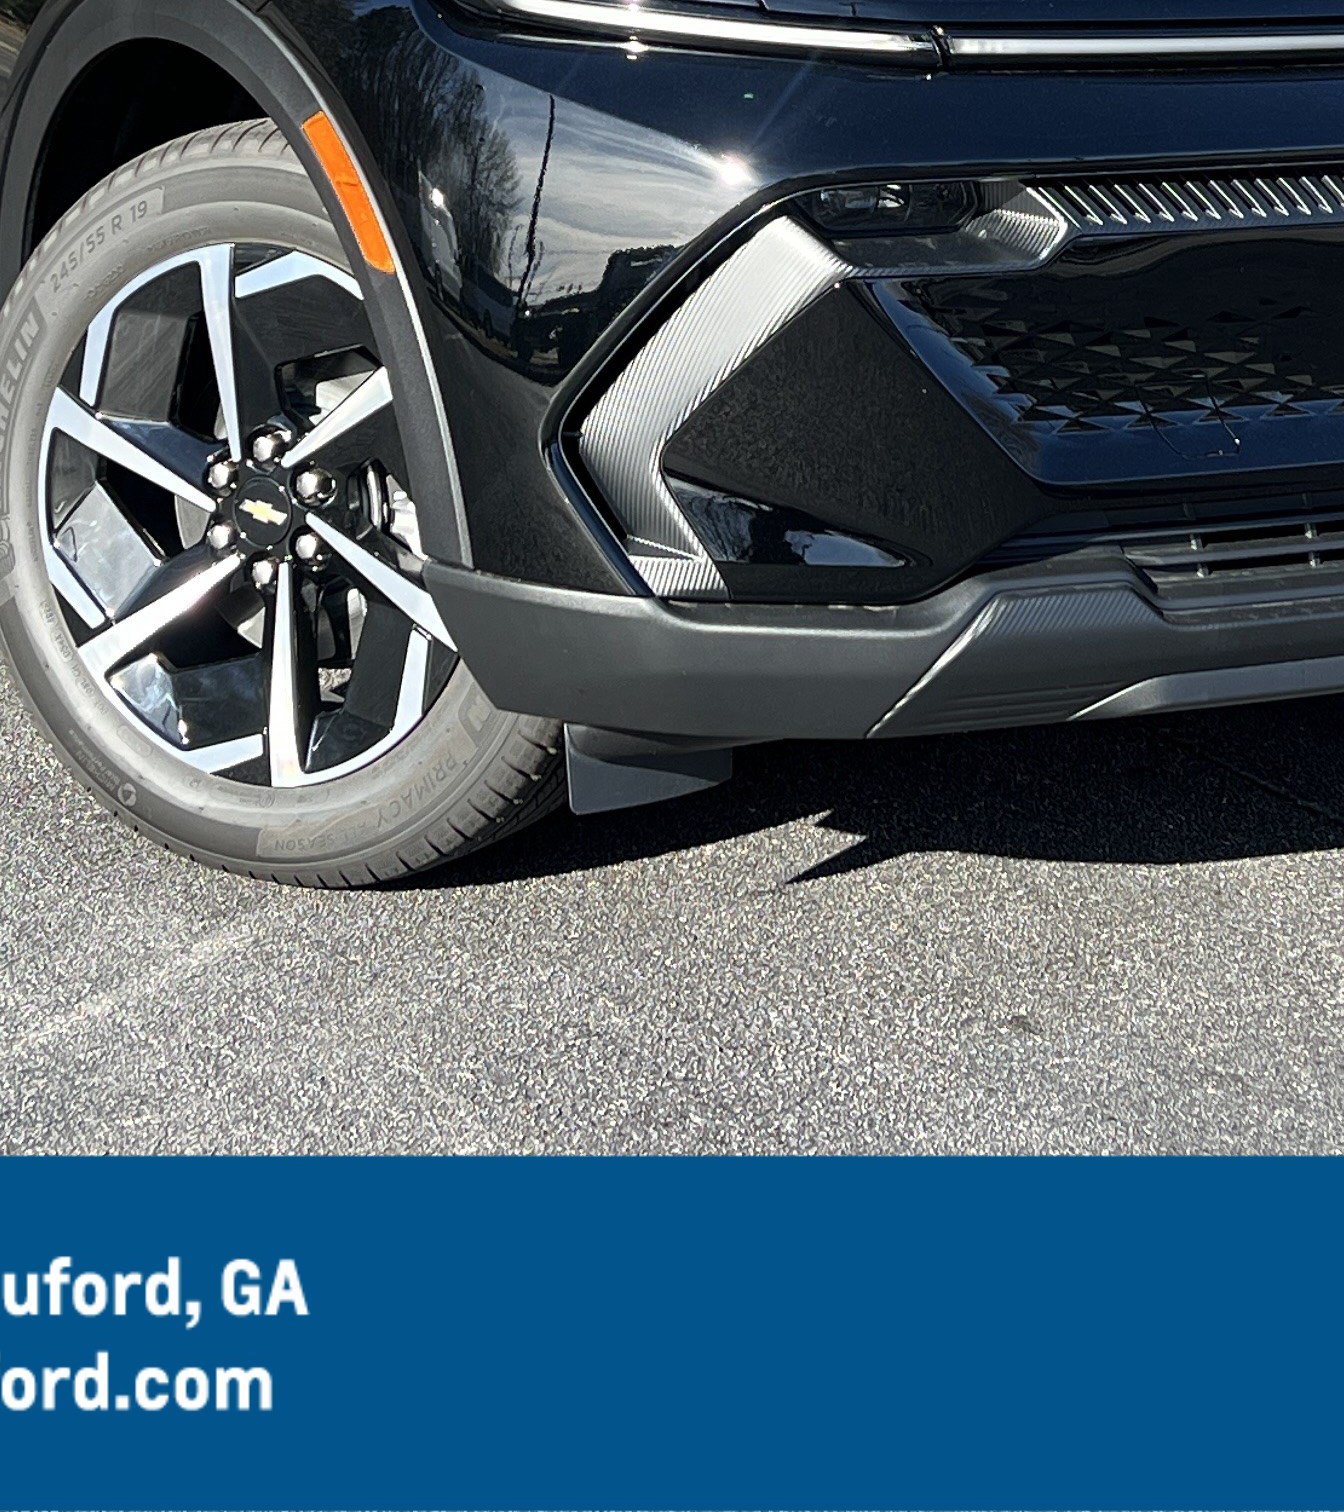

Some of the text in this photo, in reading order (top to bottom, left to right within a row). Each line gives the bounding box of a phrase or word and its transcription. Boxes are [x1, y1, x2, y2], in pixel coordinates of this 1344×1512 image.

[49, 225, 106, 293] 245/55
[111, 214, 122, 235] R
[130, 200, 148, 223] 19
[374, 750, 457, 829] PRIMACY
